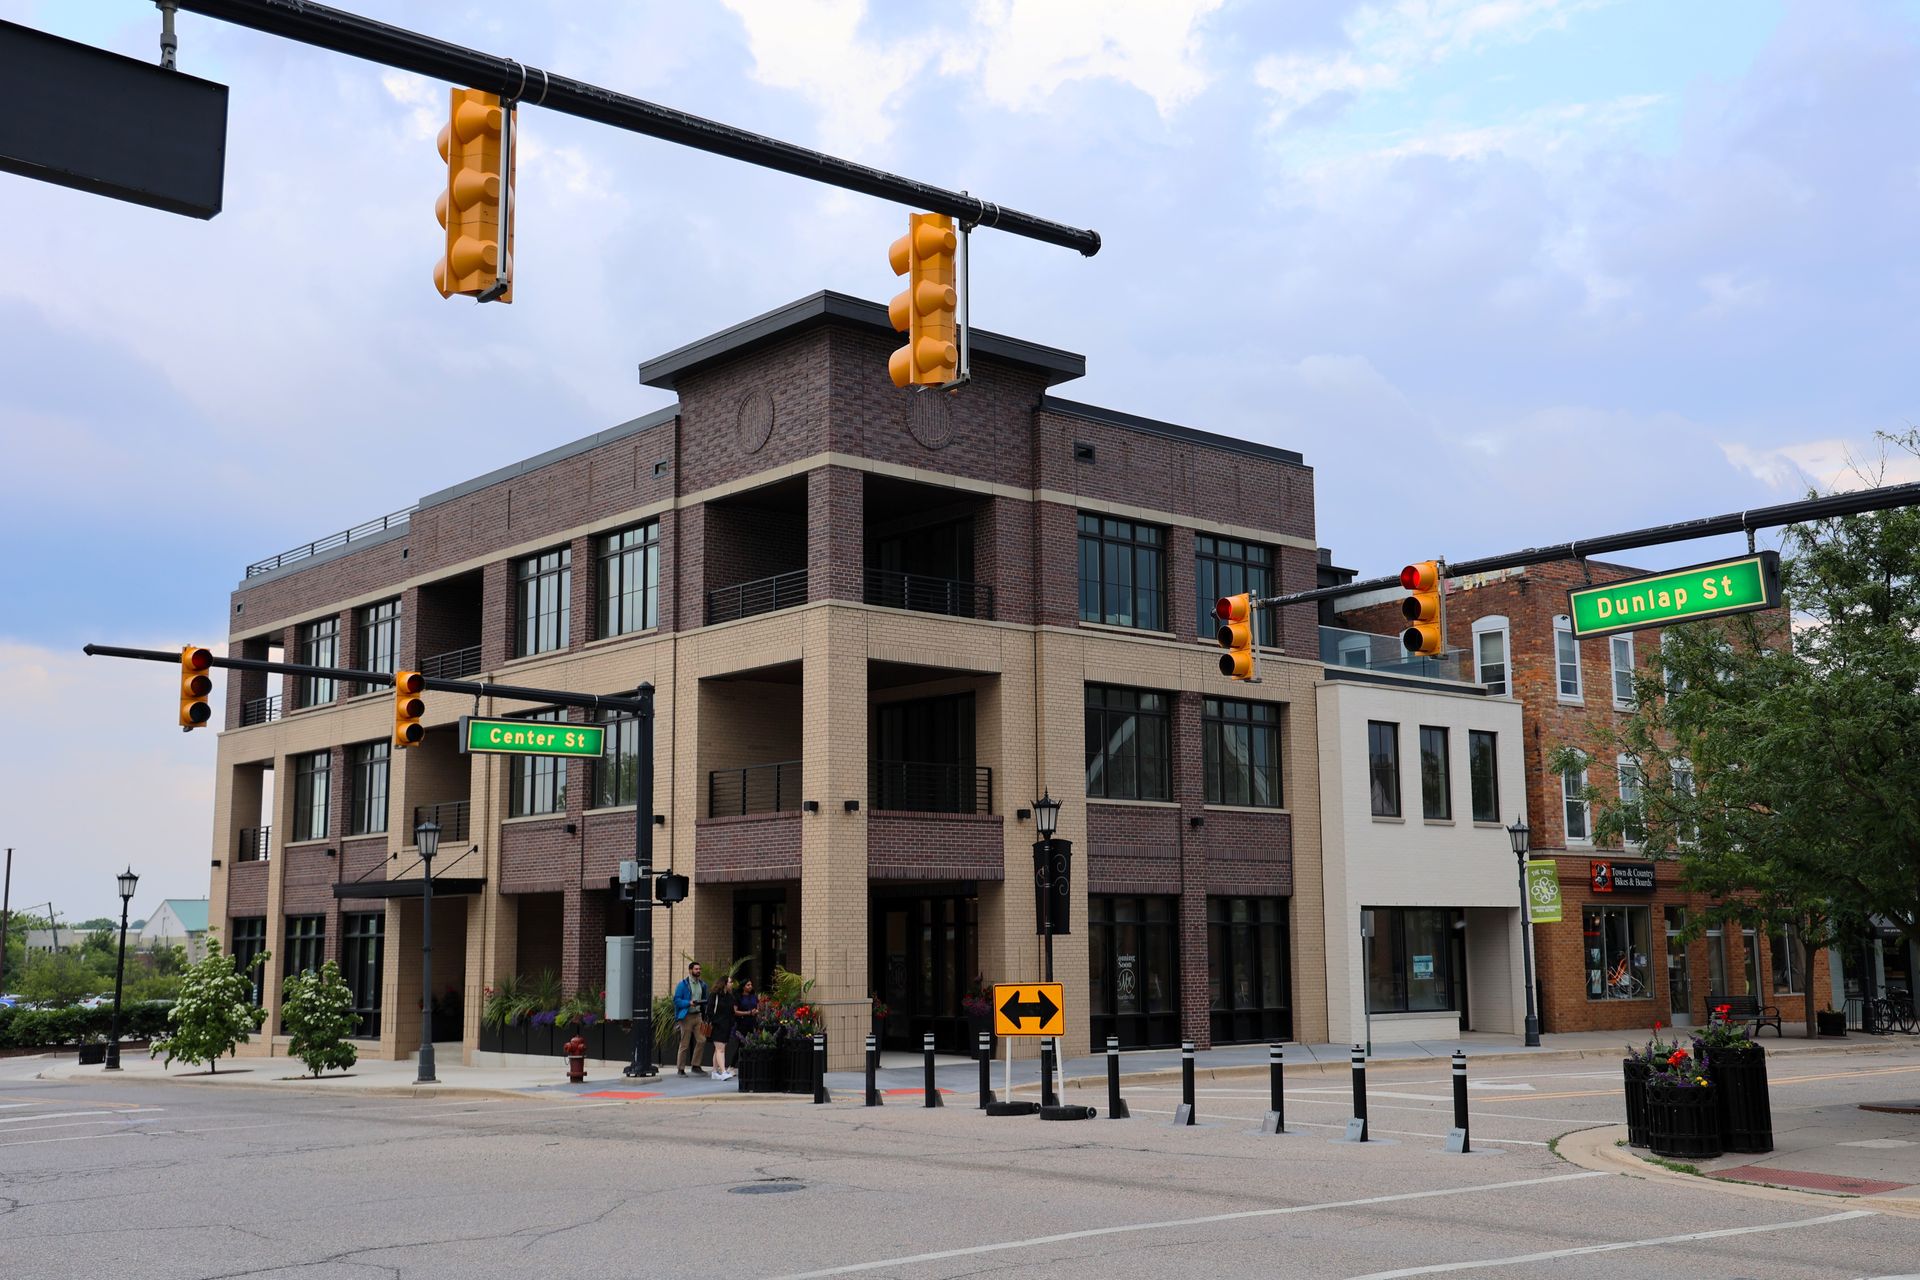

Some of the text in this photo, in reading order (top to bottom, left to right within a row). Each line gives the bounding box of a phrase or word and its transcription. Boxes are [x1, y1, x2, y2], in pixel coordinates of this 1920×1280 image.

[1597, 575, 1733, 618] Dunlap St
[490, 728, 585, 748] Center St
[1611, 867, 1653, 879] Town & Country
[1614, 876, 1652, 887] Bikes & Boards
